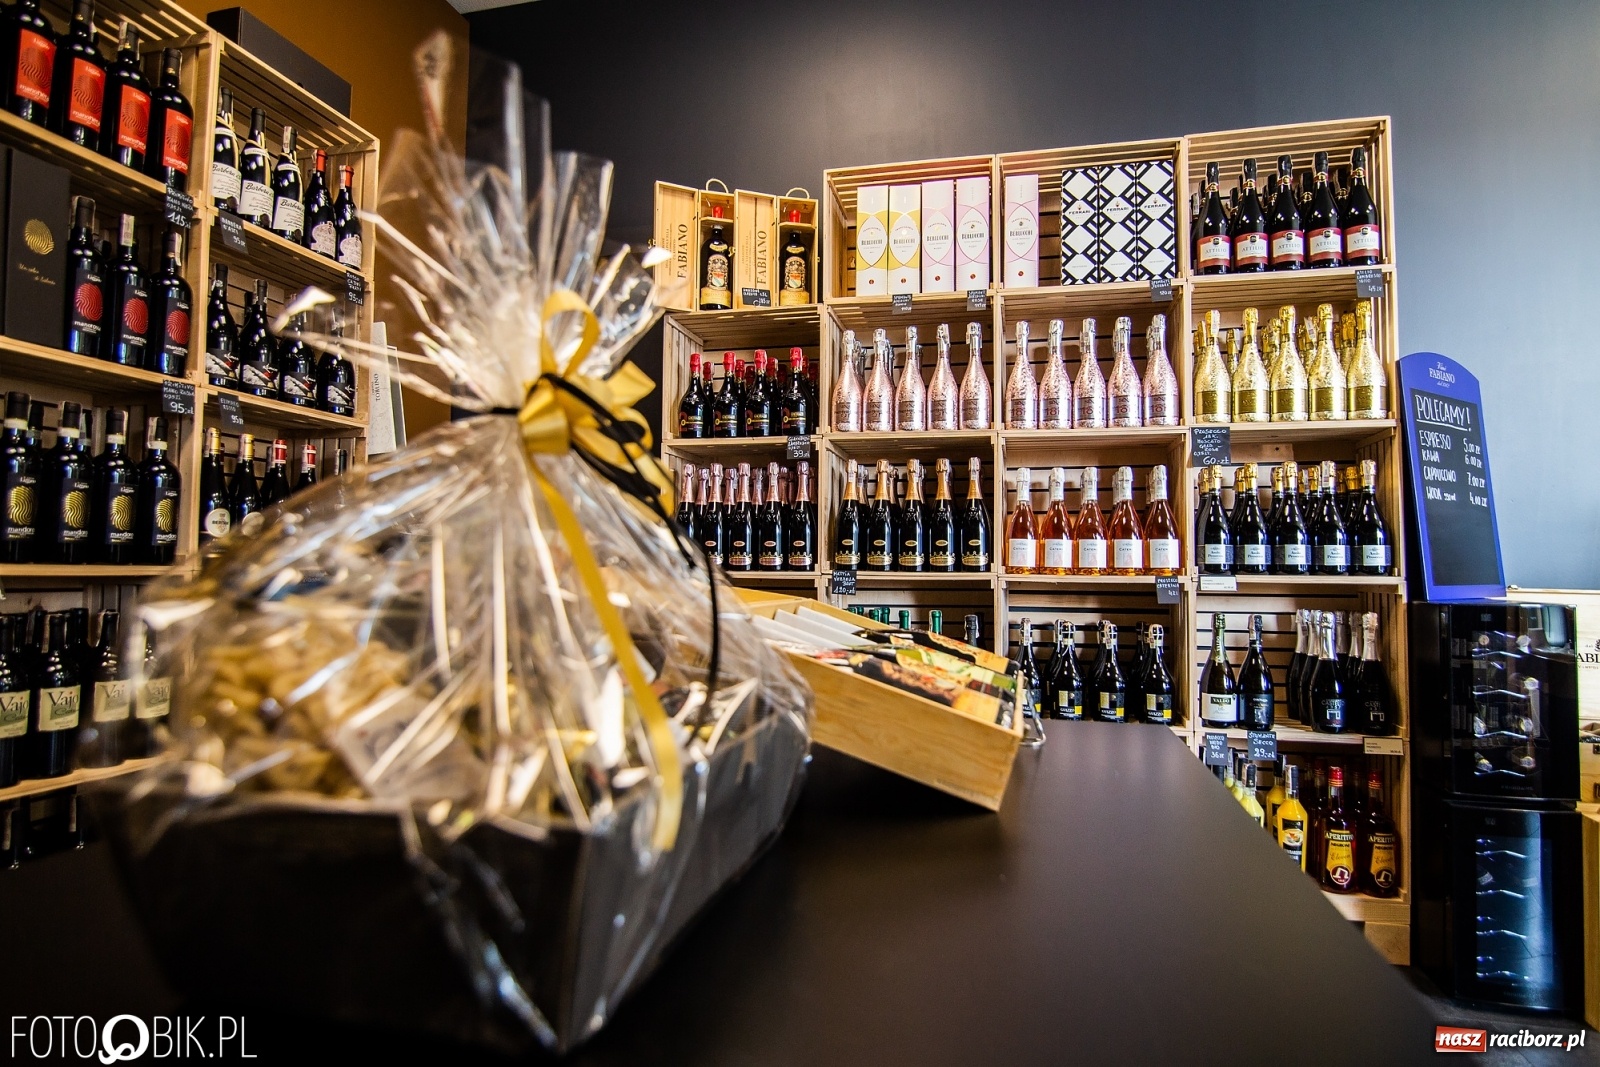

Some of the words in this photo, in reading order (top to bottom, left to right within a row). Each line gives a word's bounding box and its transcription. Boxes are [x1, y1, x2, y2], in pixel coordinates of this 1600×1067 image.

[677, 223, 688, 278] FABIANO
[757, 230, 767, 284] FABIANO
[1429, 367, 1456, 384] FABIANO
[1419, 430, 1451, 450] ESPRESSO
[1422, 448, 1440, 463] KAWA
[1465, 454, 1476, 466] 6.00
[1467, 472, 1479, 487] 7.00
[1426, 486, 1442, 500] WODA
[48, 691, 78, 707] Vajo
